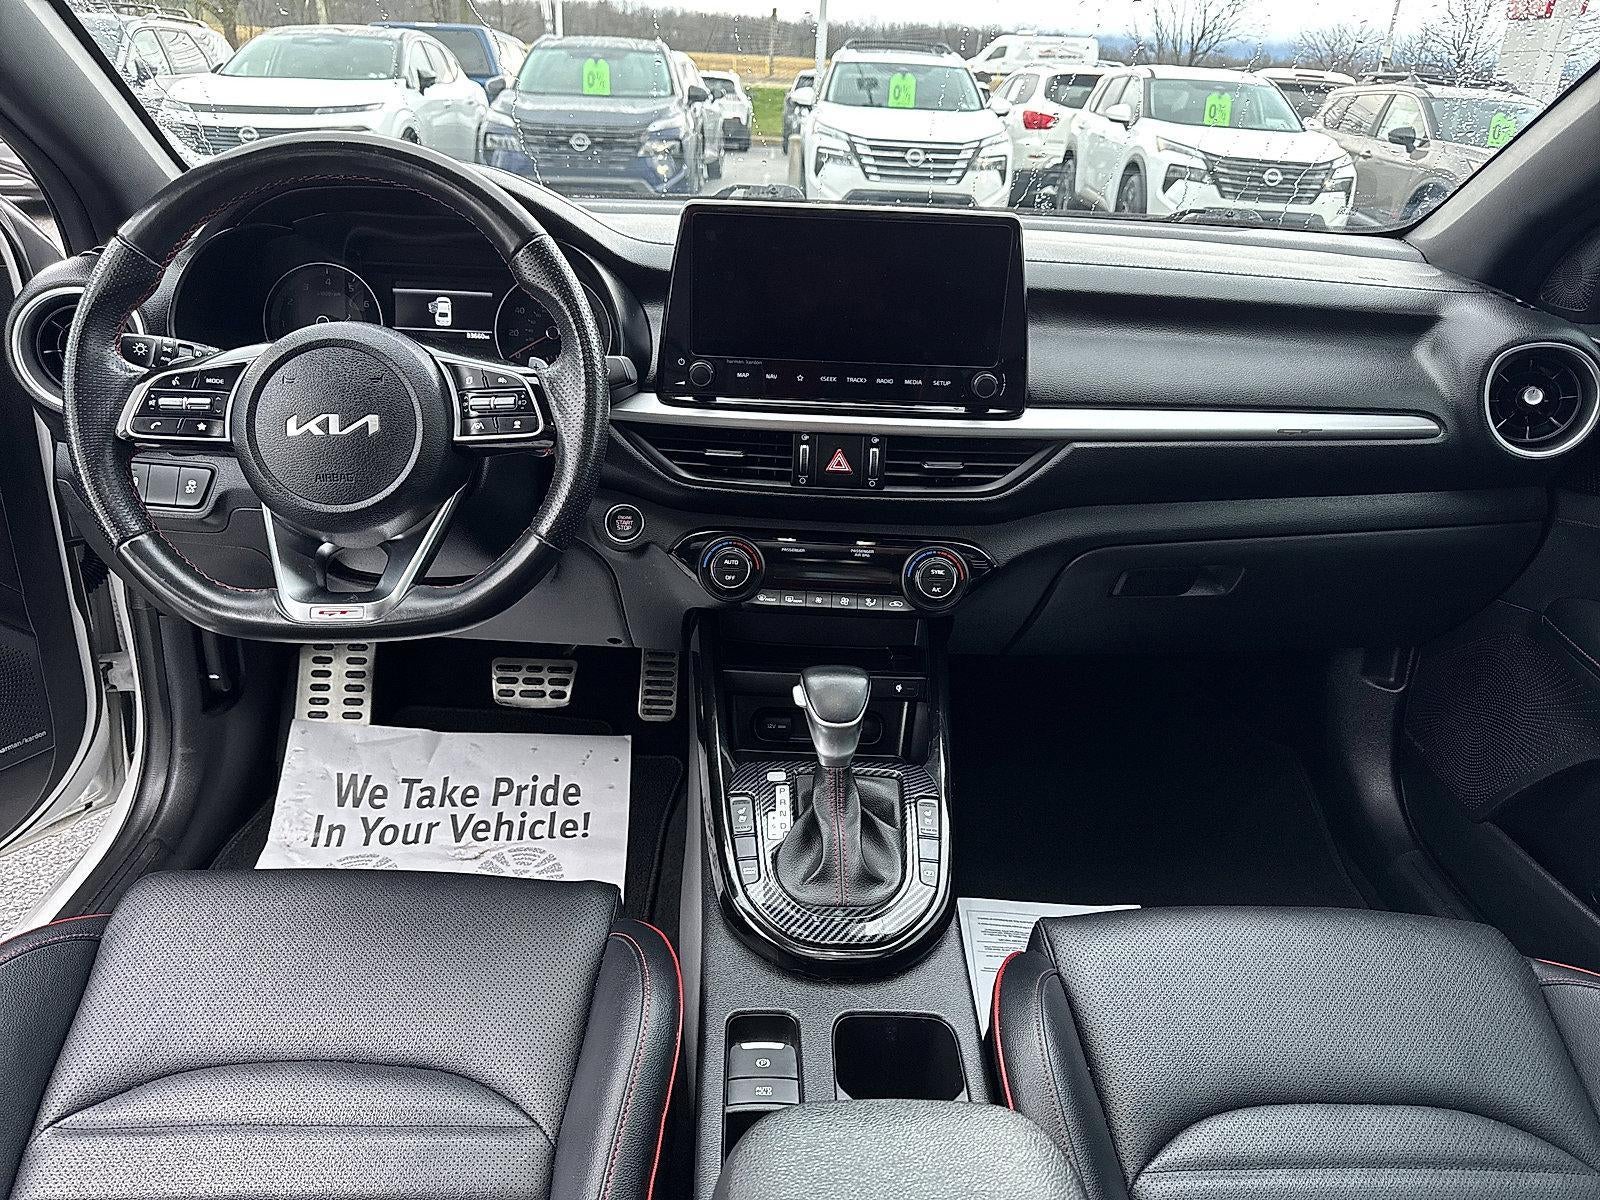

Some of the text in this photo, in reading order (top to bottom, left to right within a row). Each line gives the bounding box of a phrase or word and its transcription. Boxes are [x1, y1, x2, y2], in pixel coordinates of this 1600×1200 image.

[286, 413, 380, 438] KIA
[0, 731, 47, 754] arman/kardon
[335, 772, 582, 811] We Take Pride
[310, 810, 591, 848] In Your Vehicle!
